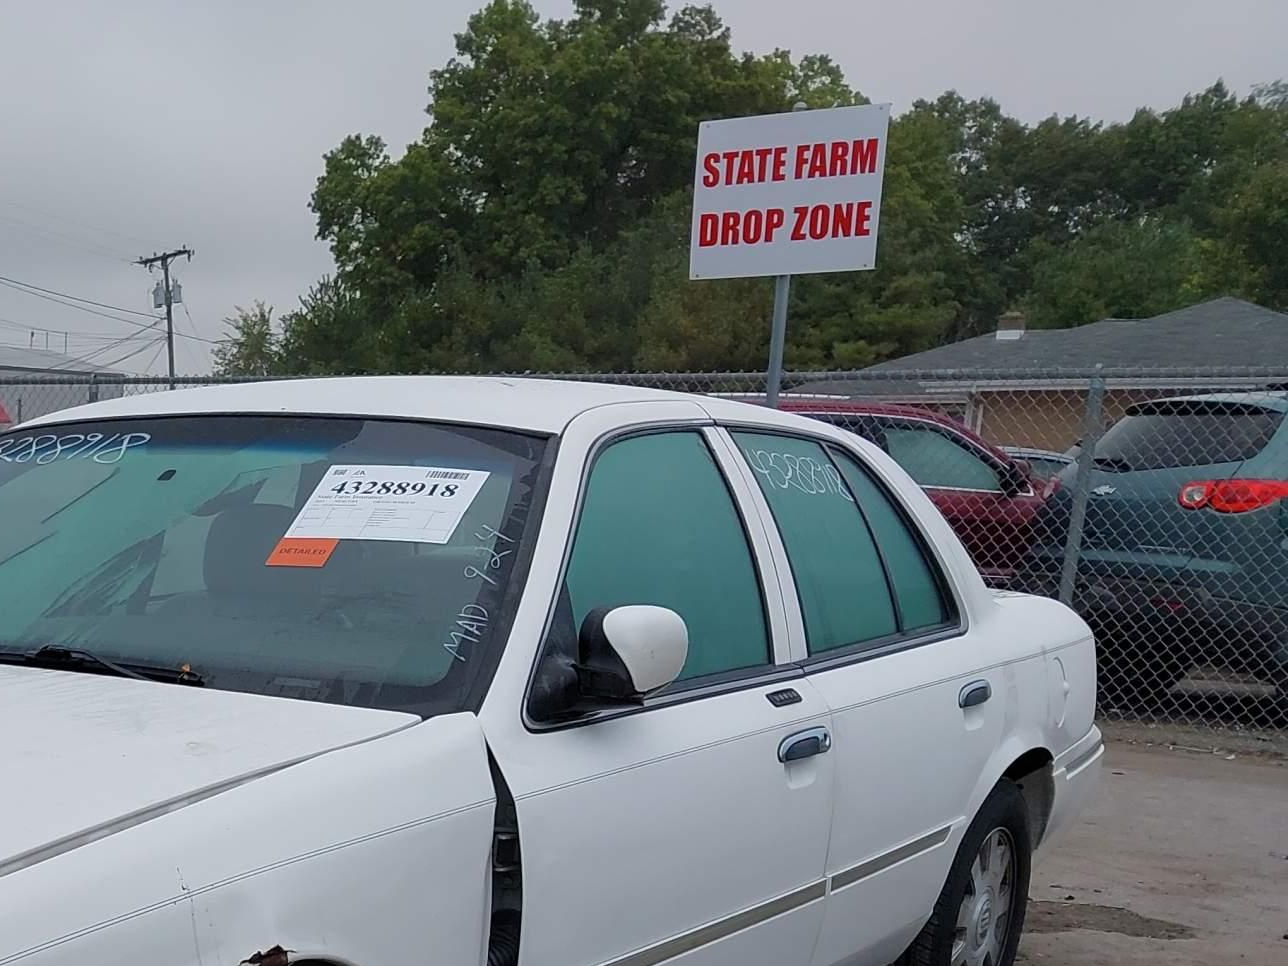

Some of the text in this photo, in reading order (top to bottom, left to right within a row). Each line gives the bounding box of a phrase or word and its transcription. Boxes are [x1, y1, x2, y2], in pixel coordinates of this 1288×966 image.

[702, 138, 879, 188] STATE FARM
[698, 200, 873, 248] DROP ZONE
[330, 480, 460, 497] 43288918
[443, 603, 489, 662] MAD
